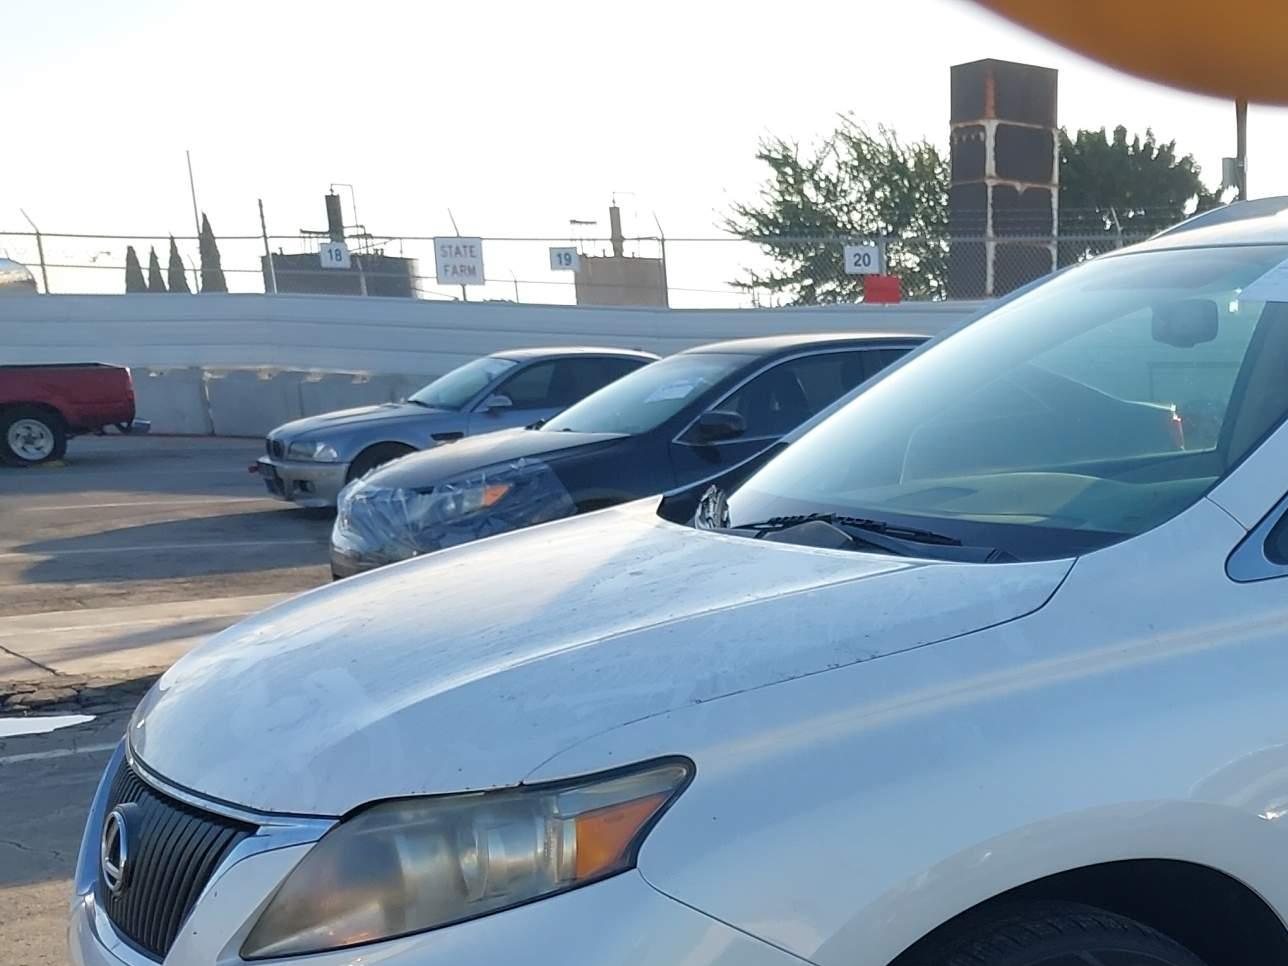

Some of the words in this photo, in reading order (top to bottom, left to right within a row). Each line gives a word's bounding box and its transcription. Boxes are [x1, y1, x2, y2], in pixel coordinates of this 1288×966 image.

[328, 248, 343, 262] 18
[440, 245, 477, 258] STATE
[557, 252, 572, 266] 19
[853, 252, 872, 267] 20
[443, 264, 477, 277] FARM
